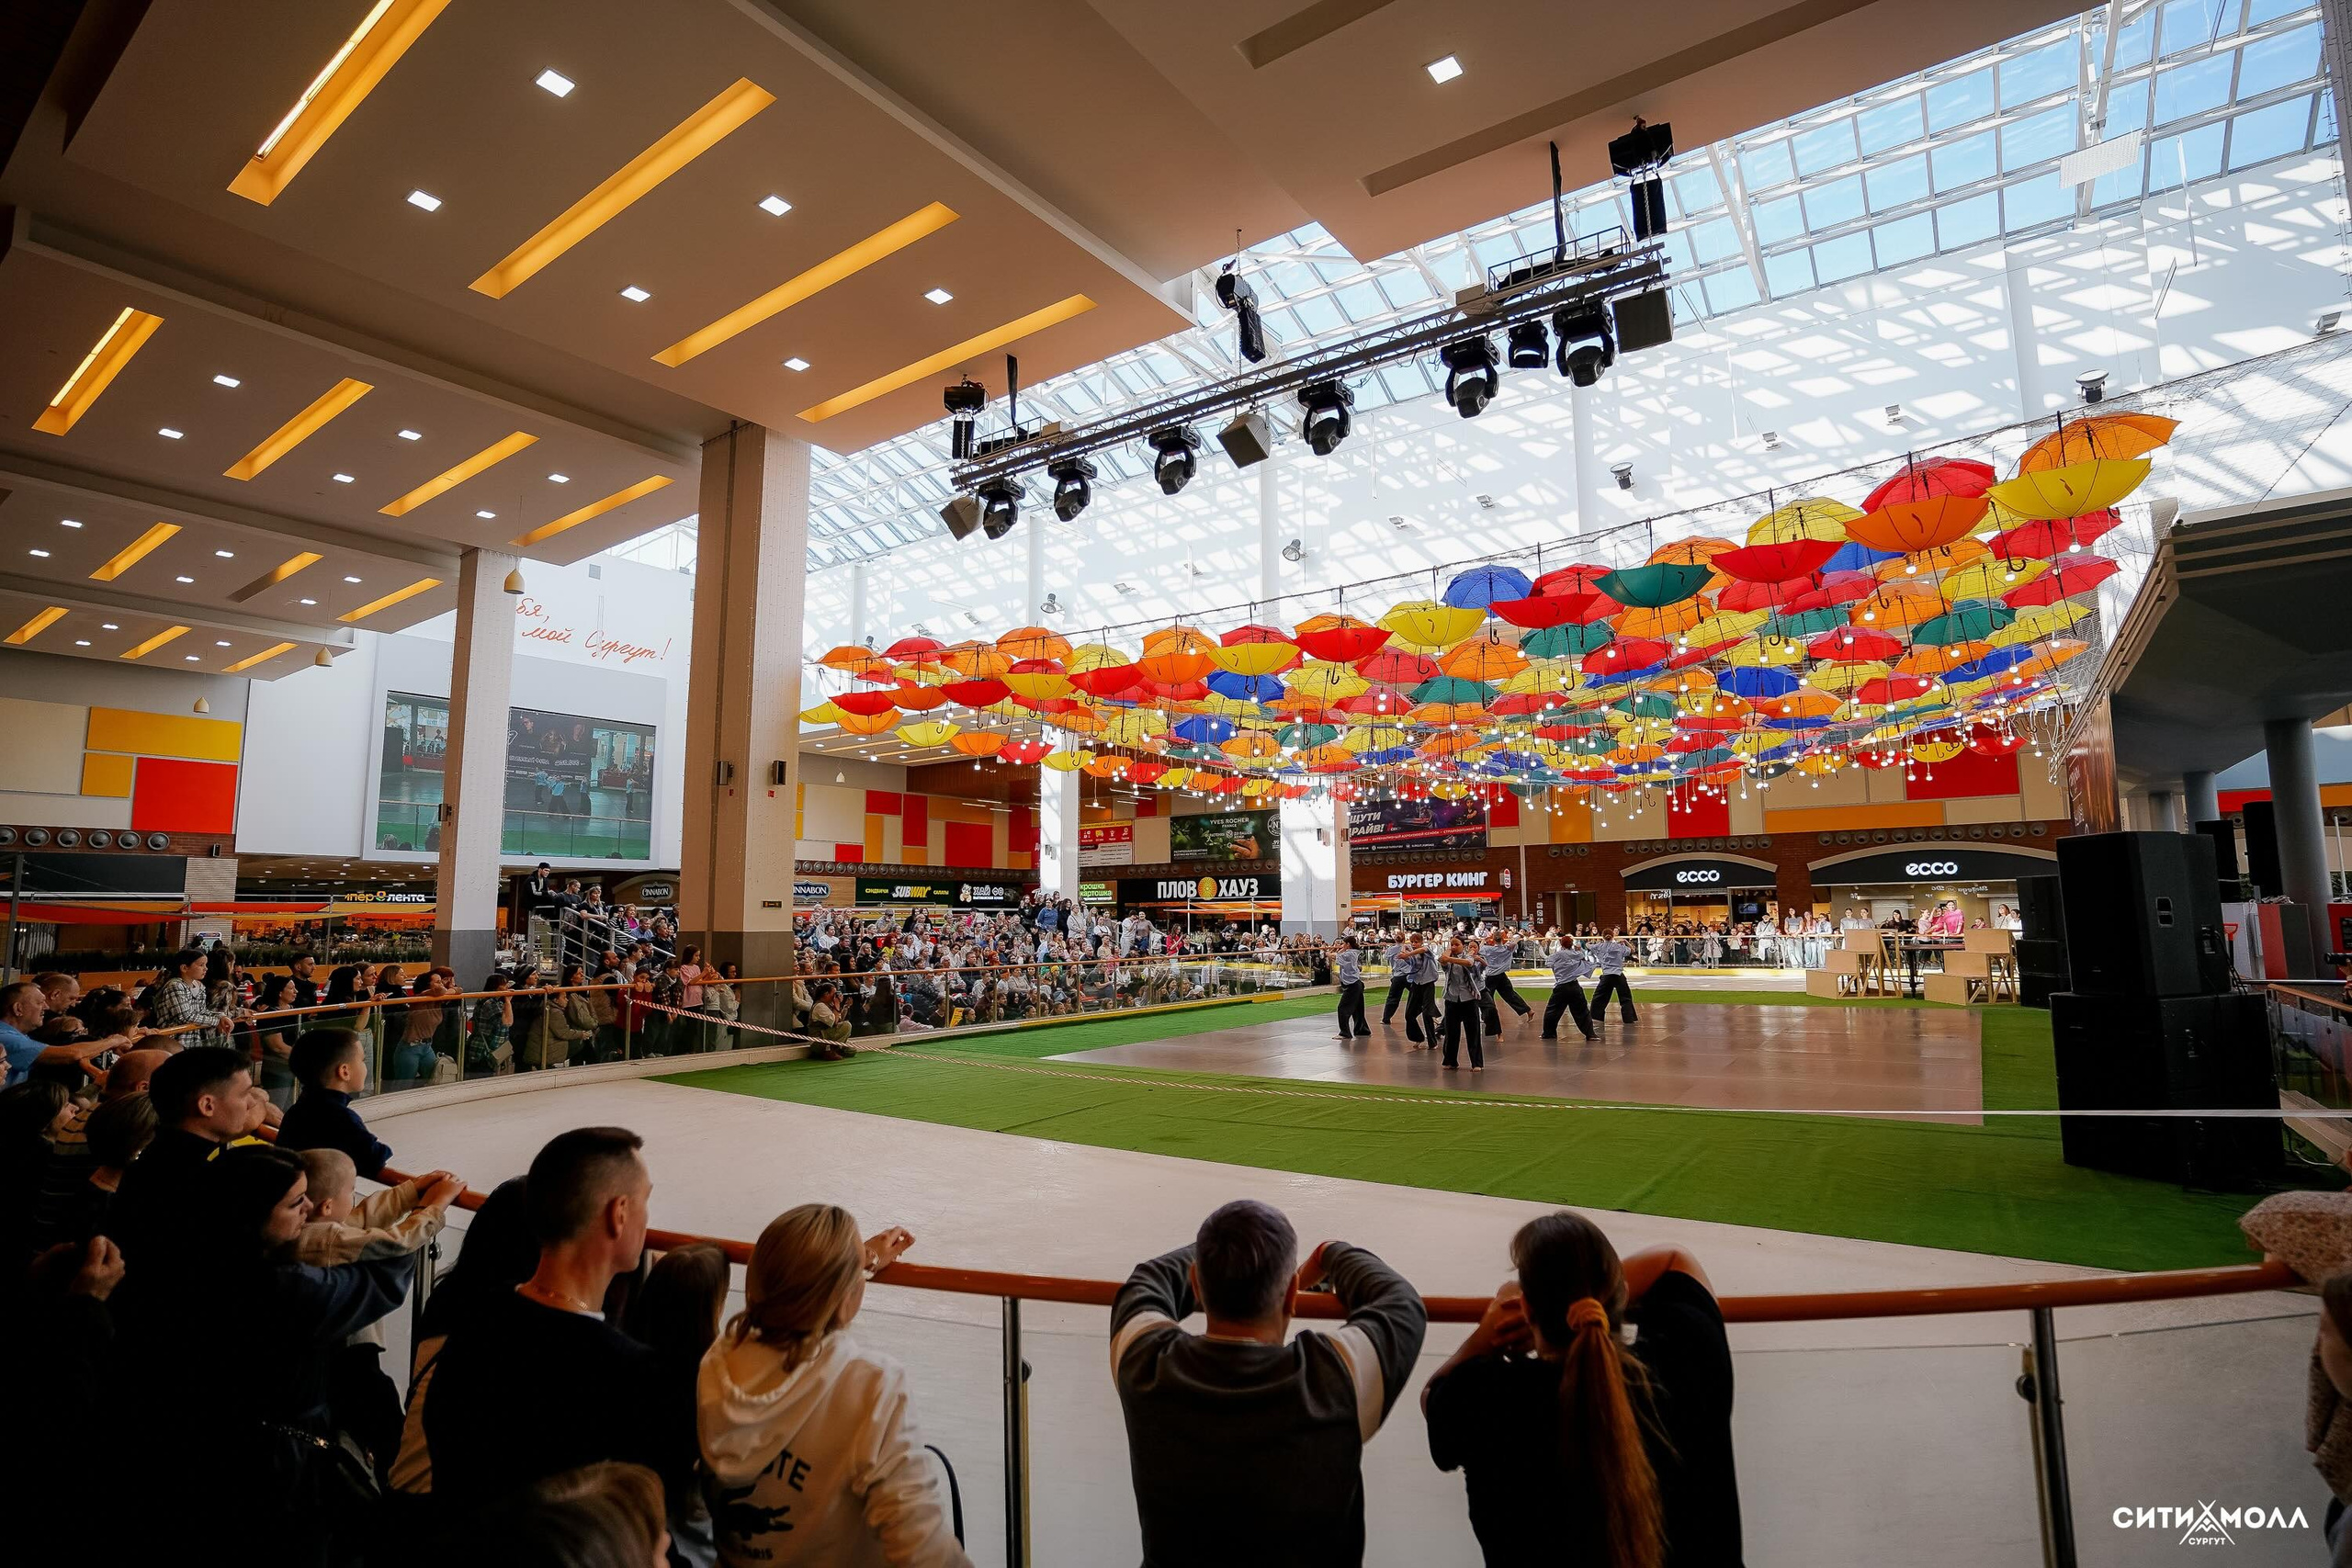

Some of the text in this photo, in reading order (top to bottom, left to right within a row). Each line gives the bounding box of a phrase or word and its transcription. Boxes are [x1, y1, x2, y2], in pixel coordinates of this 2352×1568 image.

[522, 627, 673, 663] мой Сургут!
[1905, 862, 1959, 875] ecco
[1387, 874, 1443, 888] БУРГЕР
[1446, 872, 1488, 886] КИНГ
[1676, 870, 1720, 883] ecco
[641, 887, 669, 897] CINNABON
[892, 886, 930, 898] SUBWAY
[1157, 878, 1259, 898] ПЛОВ ХАУЗ
[387, 894, 425, 902] лента
